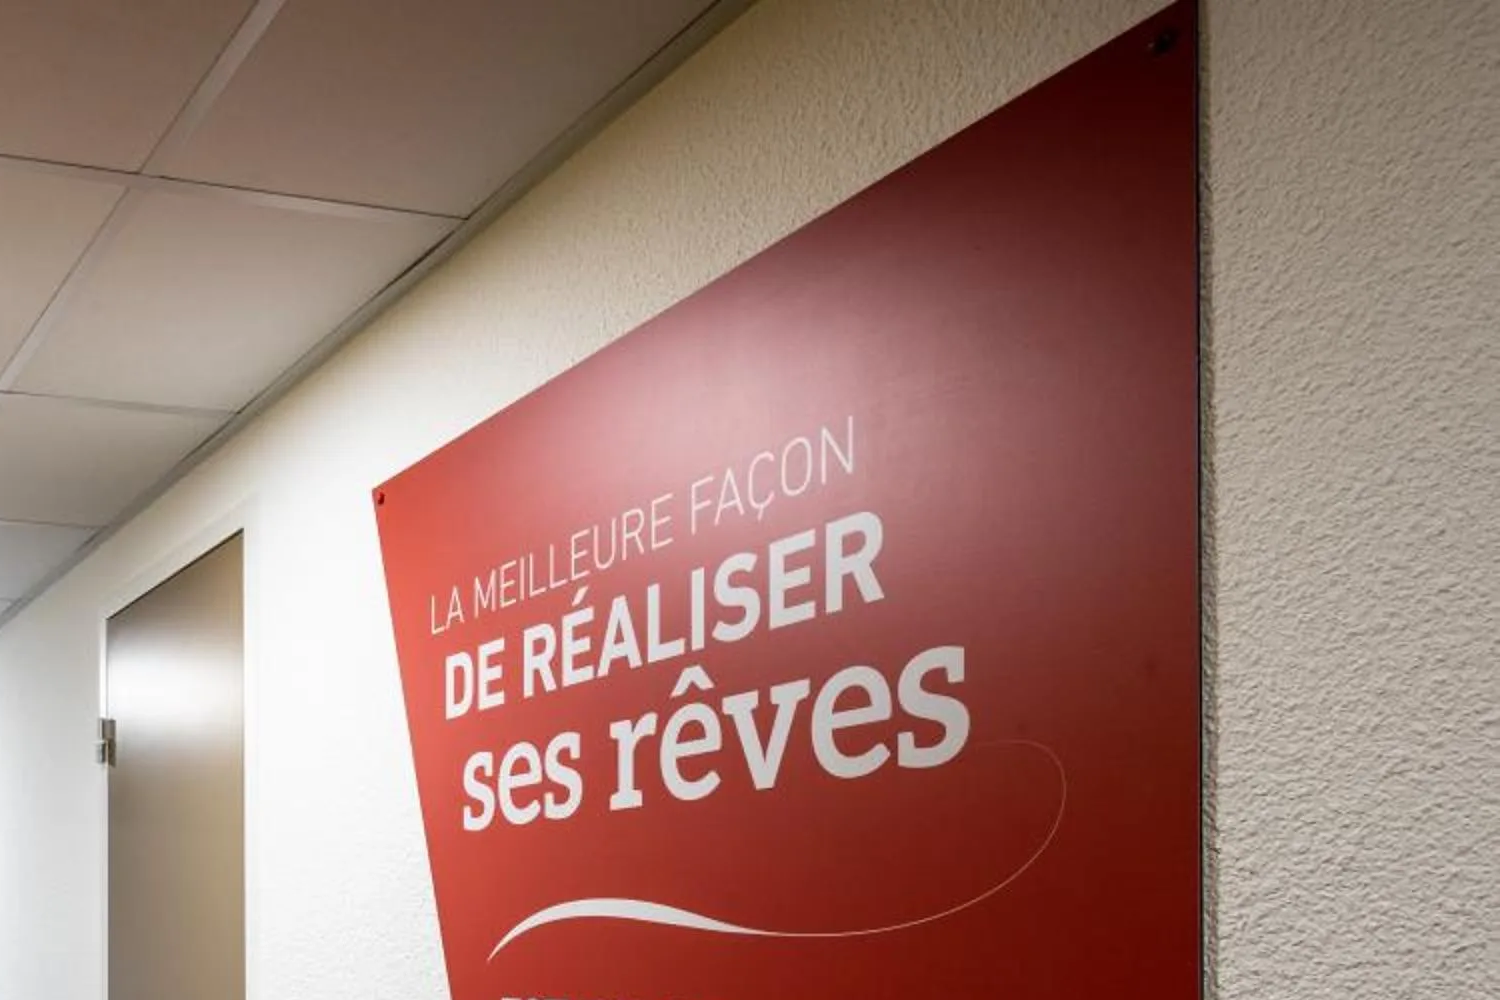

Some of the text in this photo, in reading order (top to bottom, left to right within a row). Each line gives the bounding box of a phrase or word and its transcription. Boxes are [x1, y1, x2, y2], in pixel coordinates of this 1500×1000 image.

[430, 415, 855, 636] LA MEILLEURE FAÇON
[444, 511, 886, 721] DE RÉALISER
[462, 644, 973, 833] ses rêves
